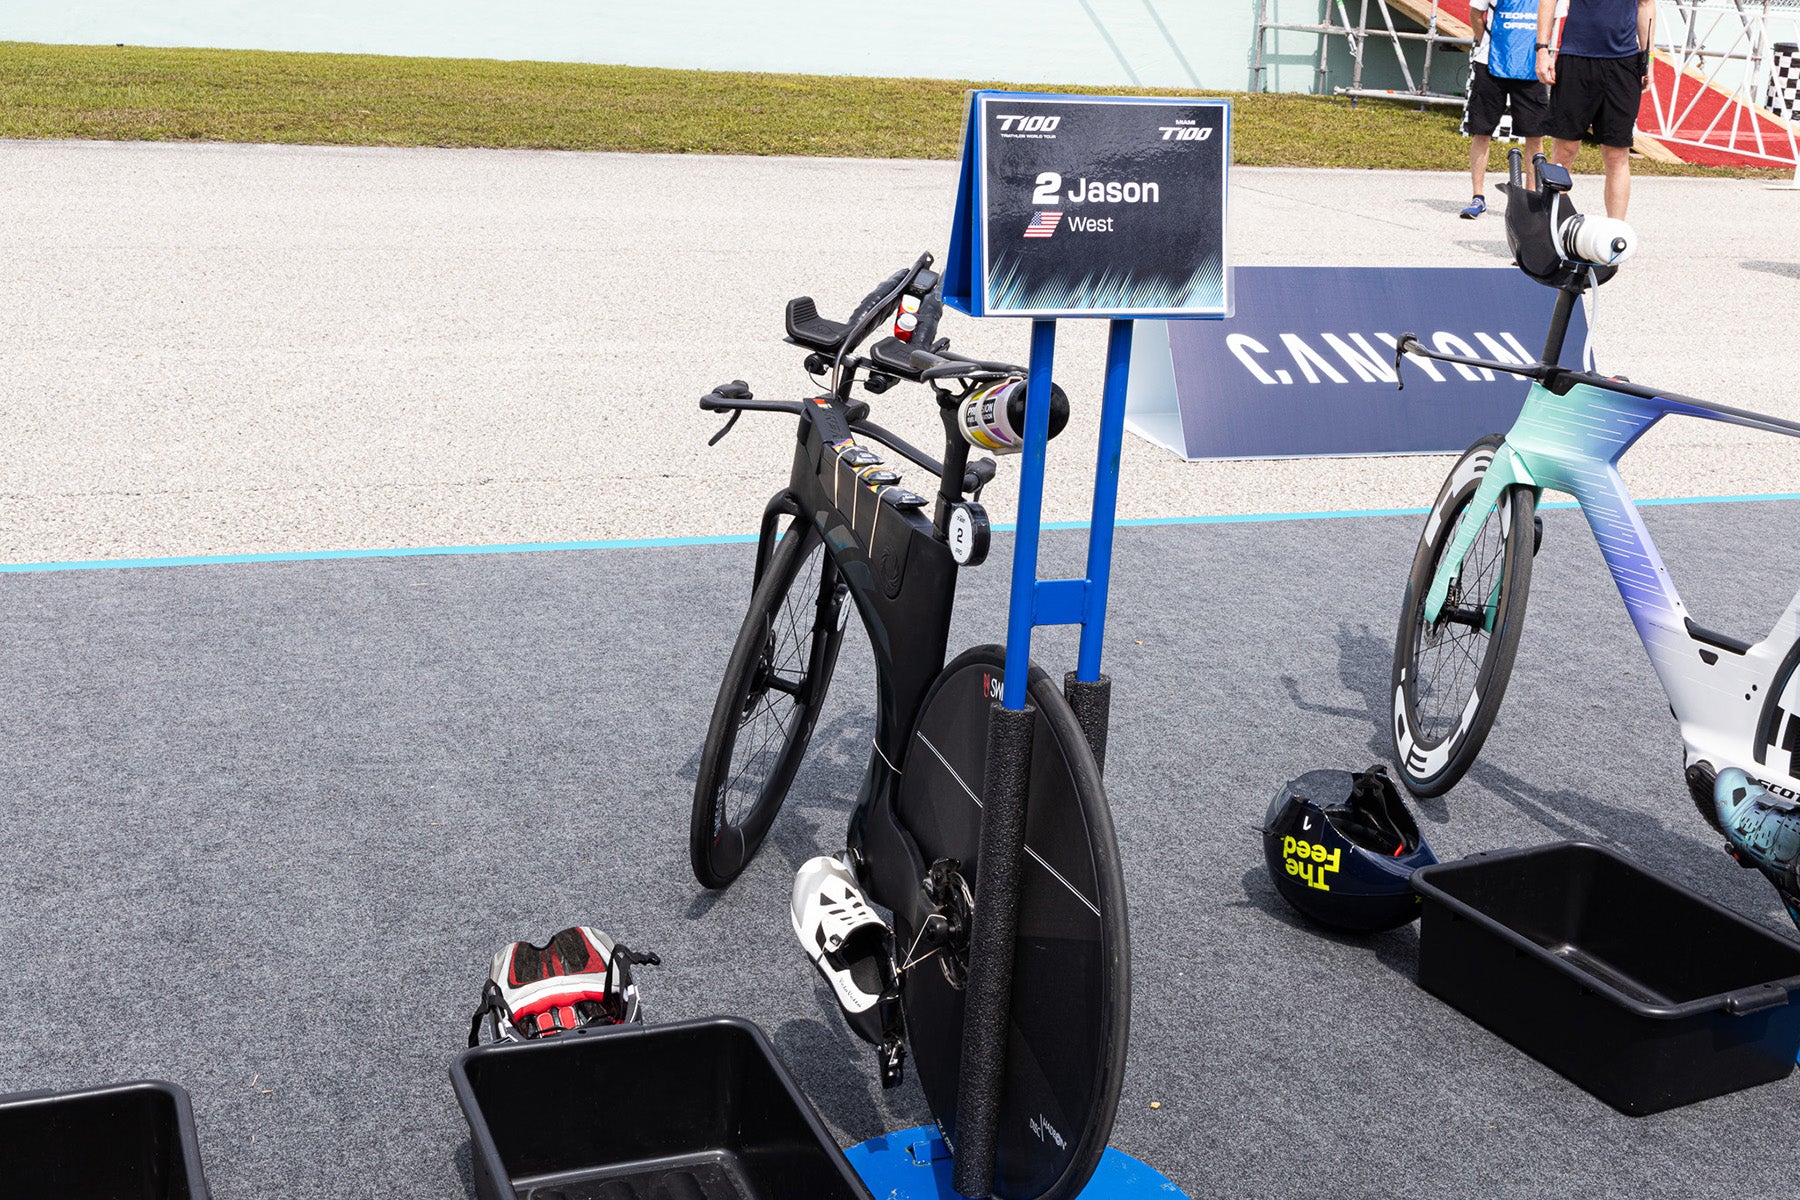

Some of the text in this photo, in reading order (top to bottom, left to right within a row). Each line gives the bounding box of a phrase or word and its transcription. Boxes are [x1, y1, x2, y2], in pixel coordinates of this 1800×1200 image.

[1503, 22, 1537, 30] OFFIC
[996, 114, 1061, 131] T100
[1158, 127, 1213, 141] T100
[1032, 171, 1159, 205] 2 Jason
[1068, 216, 1114, 232] West
[1226, 331, 1541, 385] CANYON
[957, 527, 963, 544] 2
[1303, 816, 1312, 831] 1
[1285, 857, 1331, 892] The
